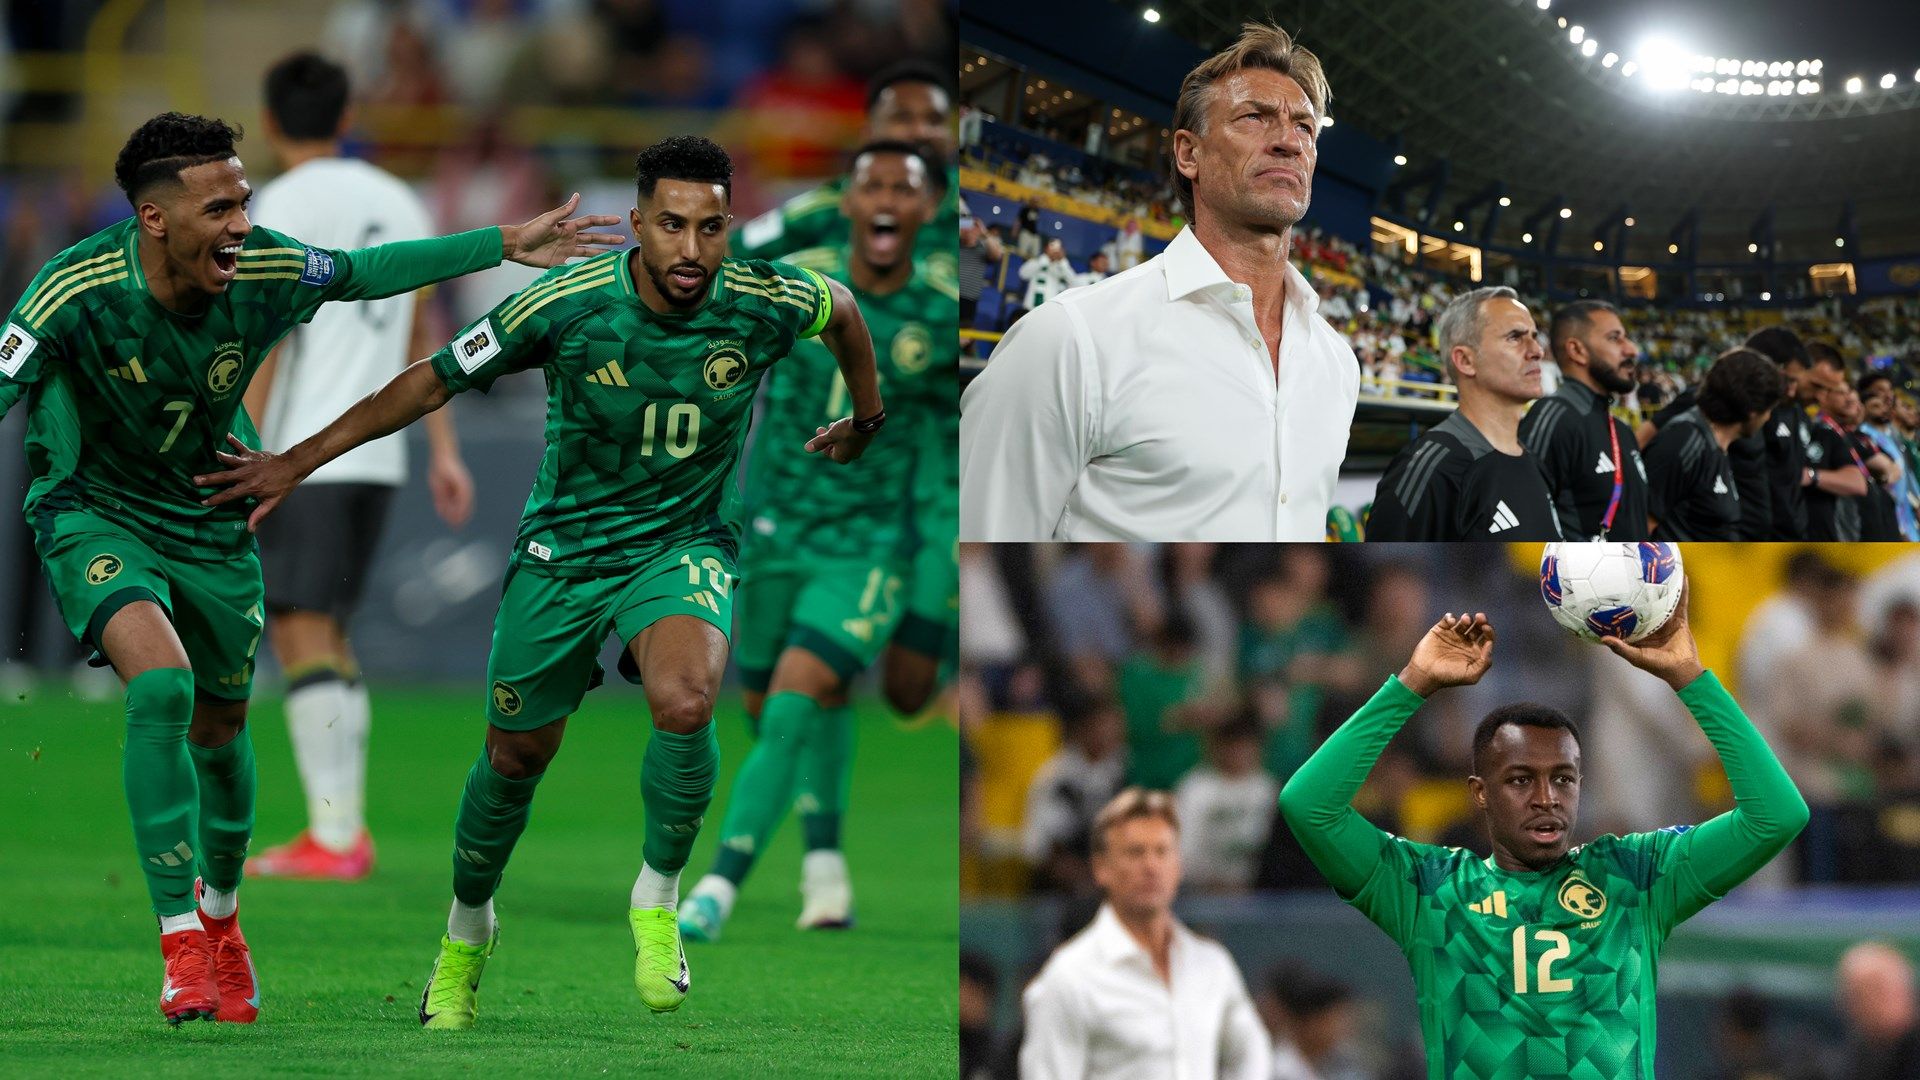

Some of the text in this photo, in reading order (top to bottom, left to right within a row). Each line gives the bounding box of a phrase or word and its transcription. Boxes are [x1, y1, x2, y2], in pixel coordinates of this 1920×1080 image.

[159, 400, 194, 453] 7
[640, 402, 701, 459] 10
[680, 553, 732, 600] 10
[1512, 924, 1574, 994] 12
